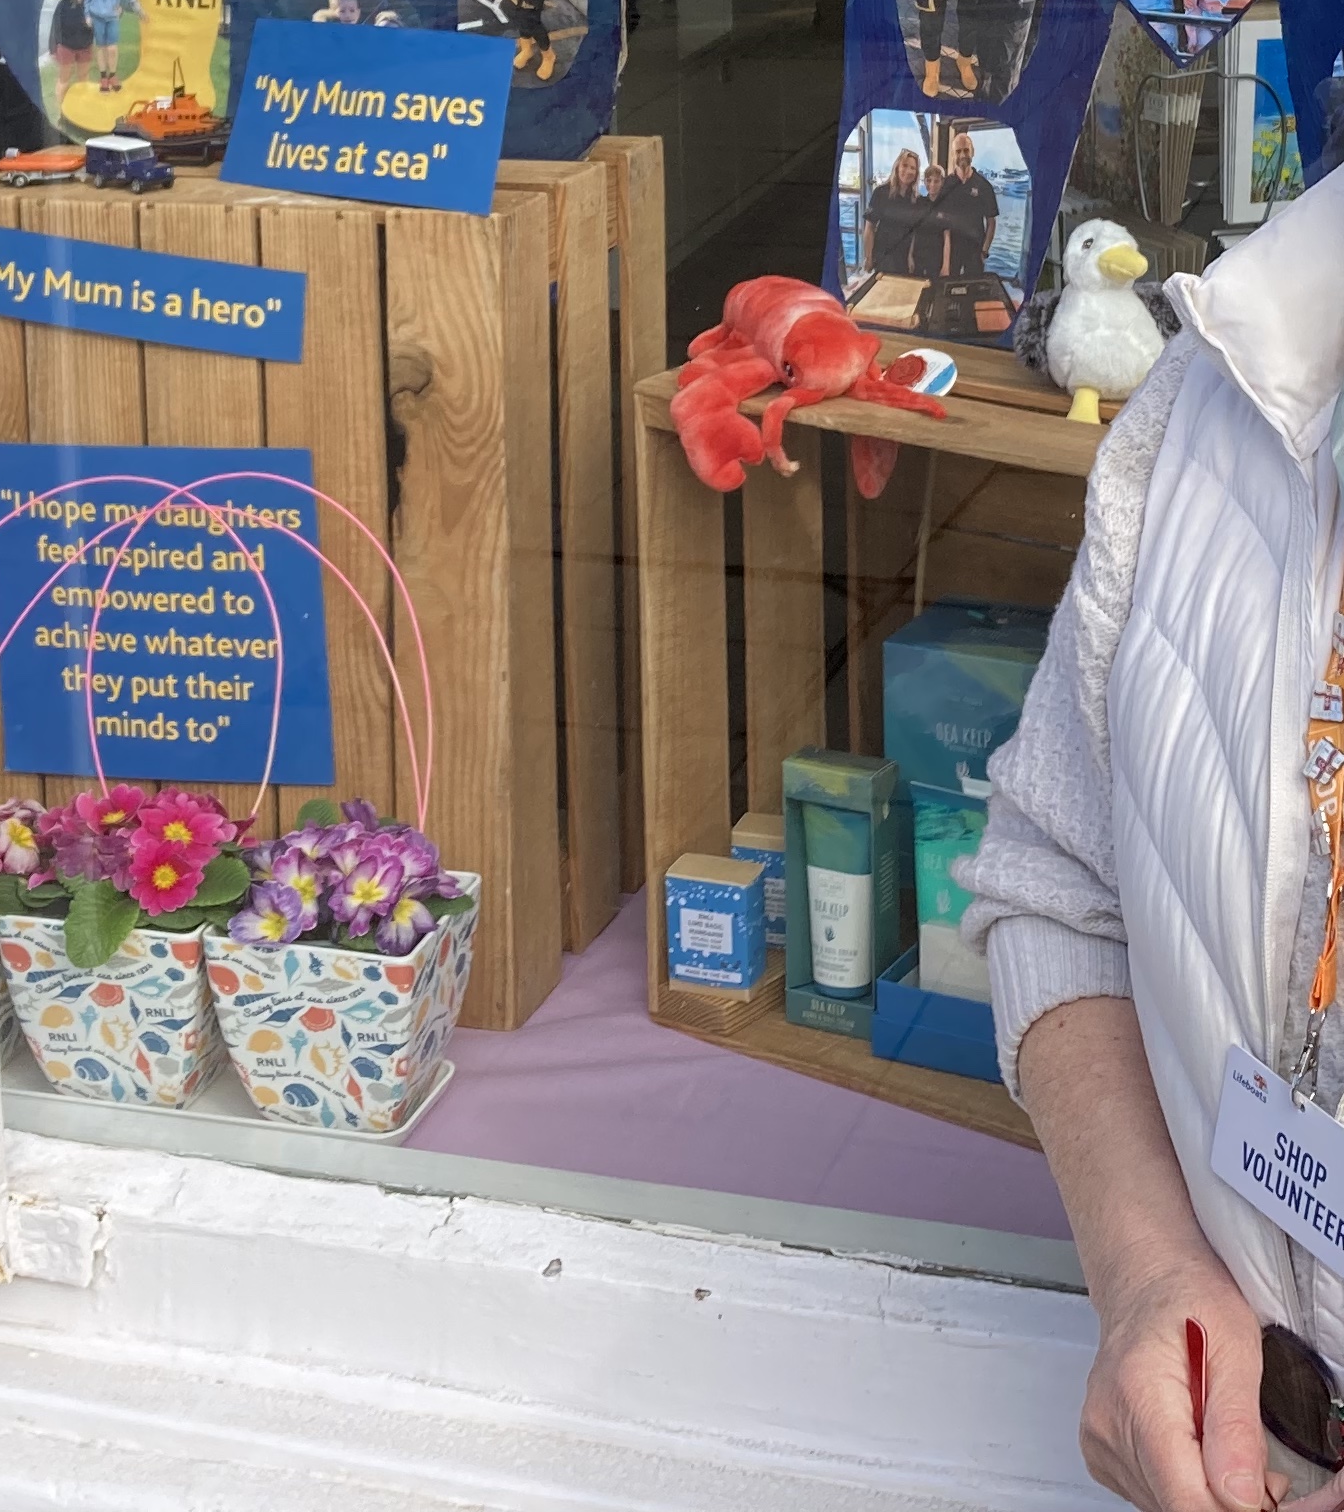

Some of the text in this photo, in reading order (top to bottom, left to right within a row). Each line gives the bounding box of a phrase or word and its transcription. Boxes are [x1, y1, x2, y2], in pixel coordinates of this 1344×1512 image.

[313, 80, 386, 118] Mum
[392, 92, 486, 127] saves
[267, 132, 330, 172] lives
[334, 142, 369, 175] at
[42, 268, 123, 309] Mum
[131, 280, 156, 314] is
[164, 294, 183, 318] a
[29, 491, 97, 528] hope
[103, 503, 149, 533] my
[156, 500, 302, 536] daughters
[37, 535, 266, 576] feel inspired and
[51, 586, 255, 617] empowered to
[34, 622, 280, 659] achieve whatever
[61, 664, 255, 704] they put their
[94, 711, 180, 741] minds
[814, 899, 827, 913] SEA
[35, 980, 64, 994] Saving
[145, 1008, 175, 1018] RNLI
[243, 1004, 275, 1018] Saving
[810, 999, 825, 1013] SEA
[48, 1032, 78, 1042] RNLI
[357, 1033, 388, 1043] RNLI
[256, 1057, 287, 1067] RNLI
[1231, 1069, 1268, 1104] Lifeboats
[1273, 1131, 1328, 1190] SHOP
